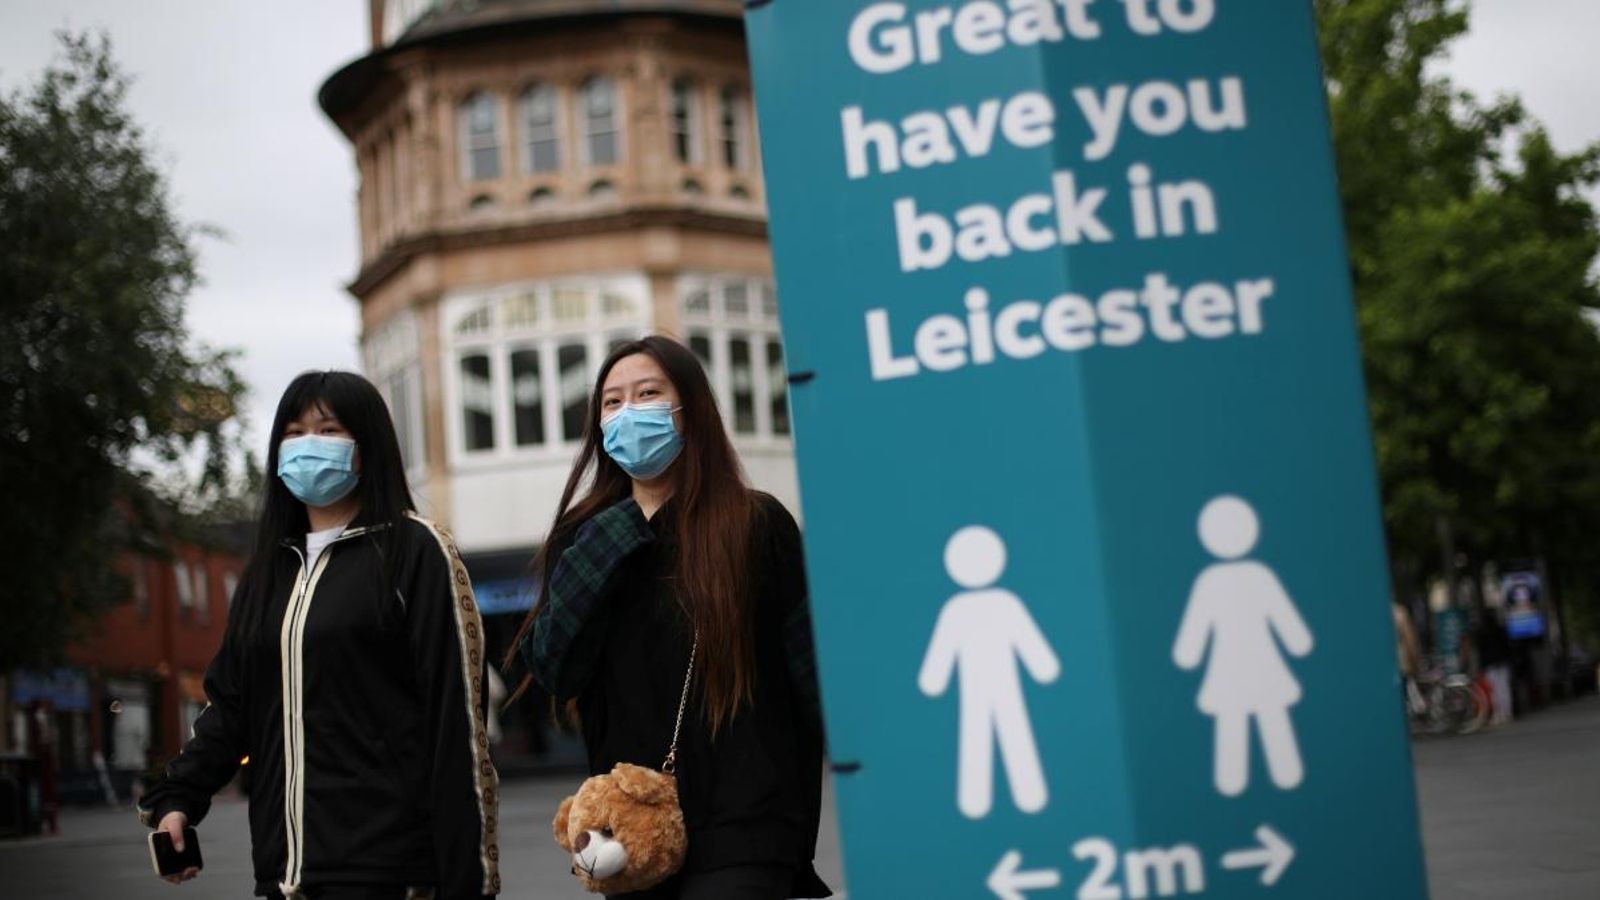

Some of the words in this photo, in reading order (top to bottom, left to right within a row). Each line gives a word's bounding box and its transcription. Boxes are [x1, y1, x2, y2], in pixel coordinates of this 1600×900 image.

[848, 0, 1101, 73] Great
[1124, 0, 1214, 36] to
[841, 92, 1055, 178] have
[1074, 78, 1245, 160] you
[894, 171, 1112, 272] back
[1128, 164, 1217, 239] in
[865, 274, 1273, 380] Leicester
[1073, 838, 1203, 900] 2m
